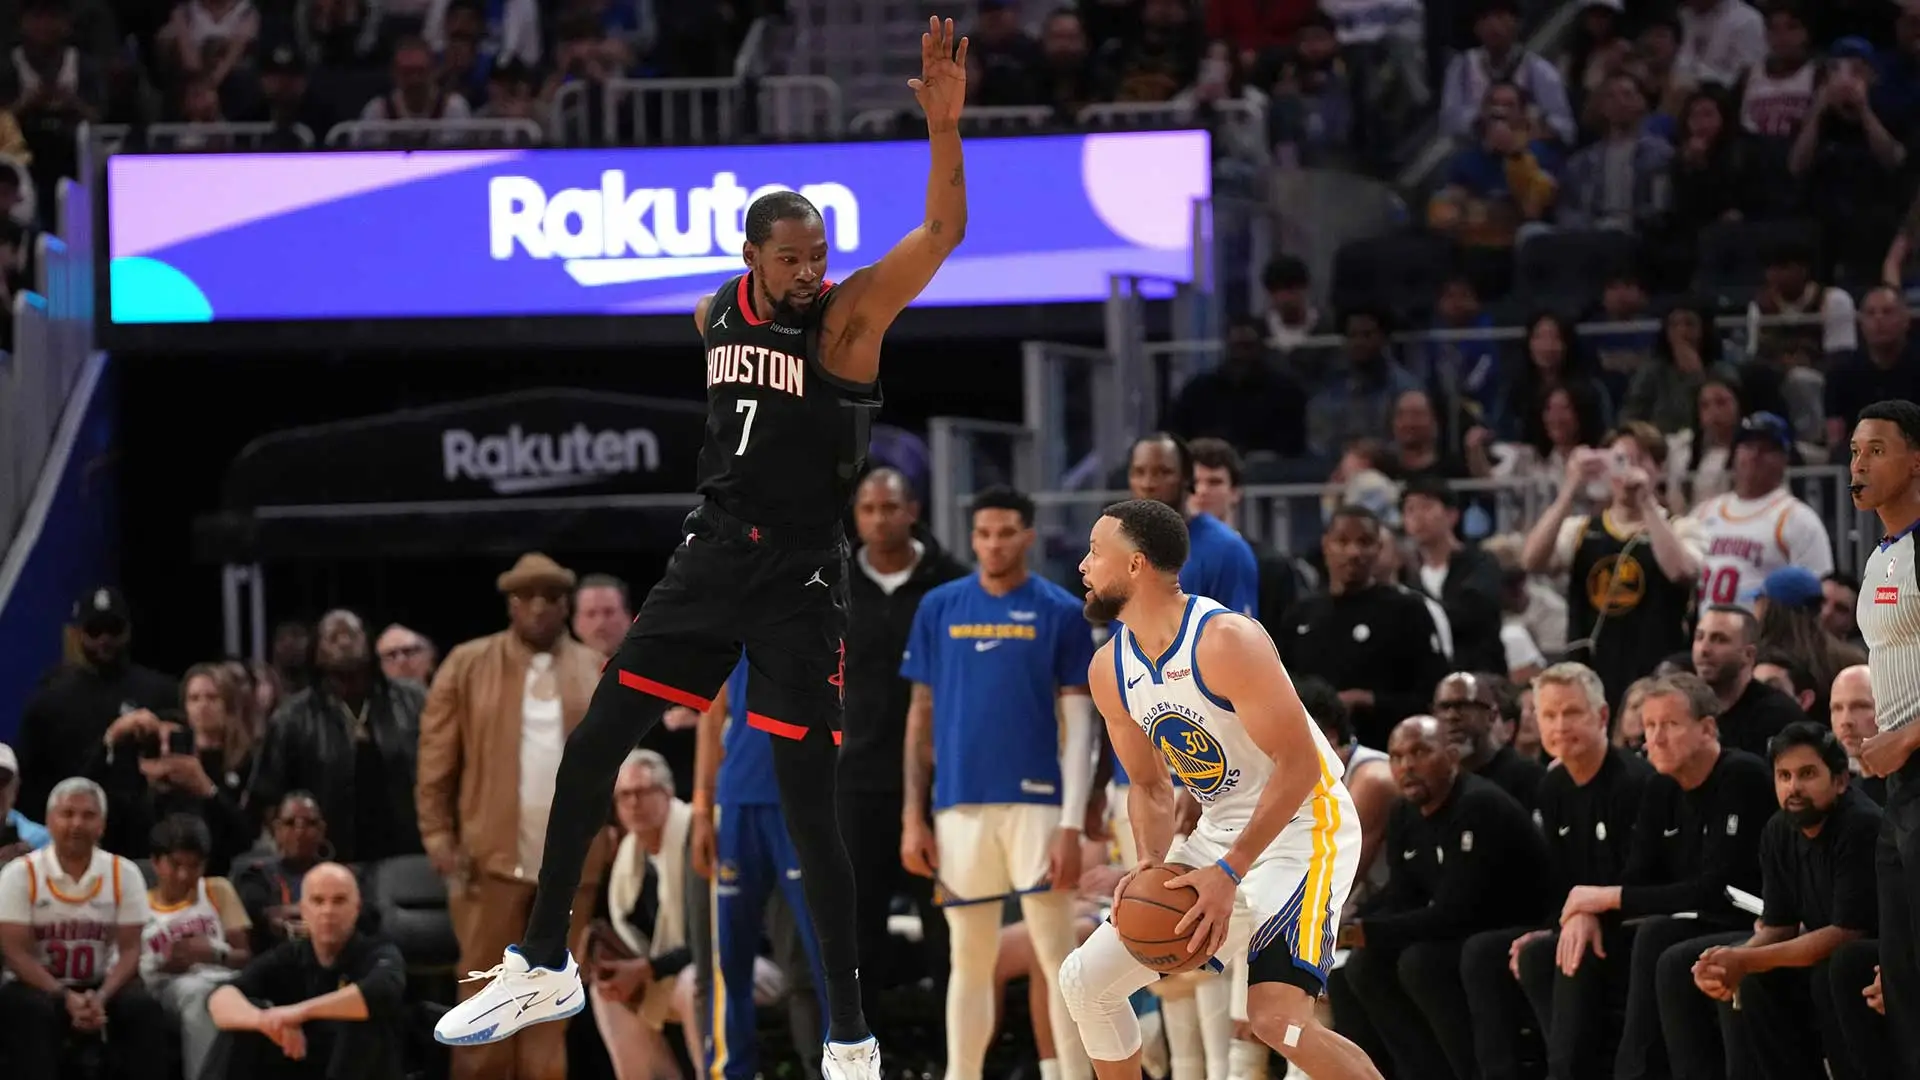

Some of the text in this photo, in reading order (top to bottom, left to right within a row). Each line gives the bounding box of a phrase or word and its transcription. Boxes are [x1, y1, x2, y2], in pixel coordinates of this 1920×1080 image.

[707, 344, 804, 397] HOUSTON
[735, 399, 758, 456] 7
[442, 422, 660, 482] Rakuten
[1173, 703, 1206, 725] STATE
[1180, 730, 1209, 755] 30
[46, 940, 95, 980] 30
